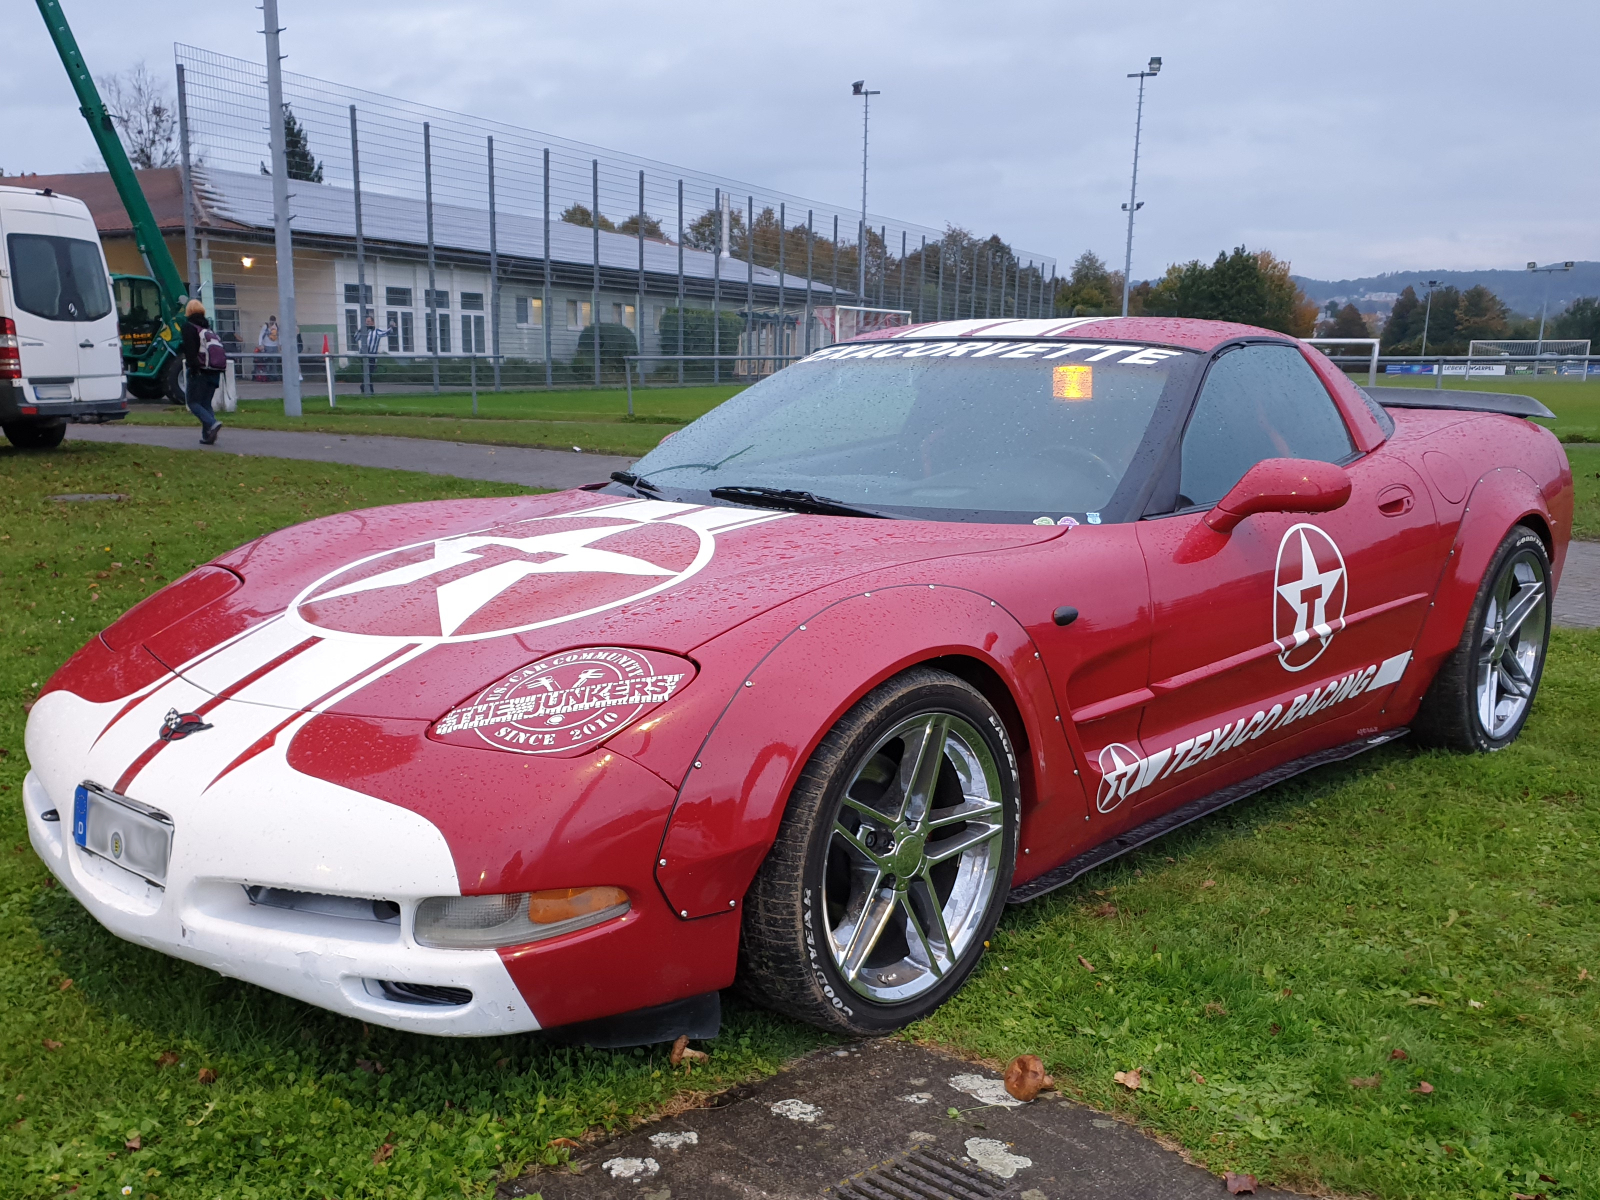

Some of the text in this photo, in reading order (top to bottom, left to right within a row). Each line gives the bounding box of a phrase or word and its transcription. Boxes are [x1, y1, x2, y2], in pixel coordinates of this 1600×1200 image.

[795, 341, 1184, 365] EXACORVETTE
[486, 650, 645, 702] US-CAR COMMUNITY
[522, 678, 672, 717] JUNKERS
[494, 711, 619, 746] SINCE 2010
[1161, 664, 1377, 779] TEXACO RACING
[78, 821, 83, 835] D
[803, 888, 853, 1017] GOODYEAR
